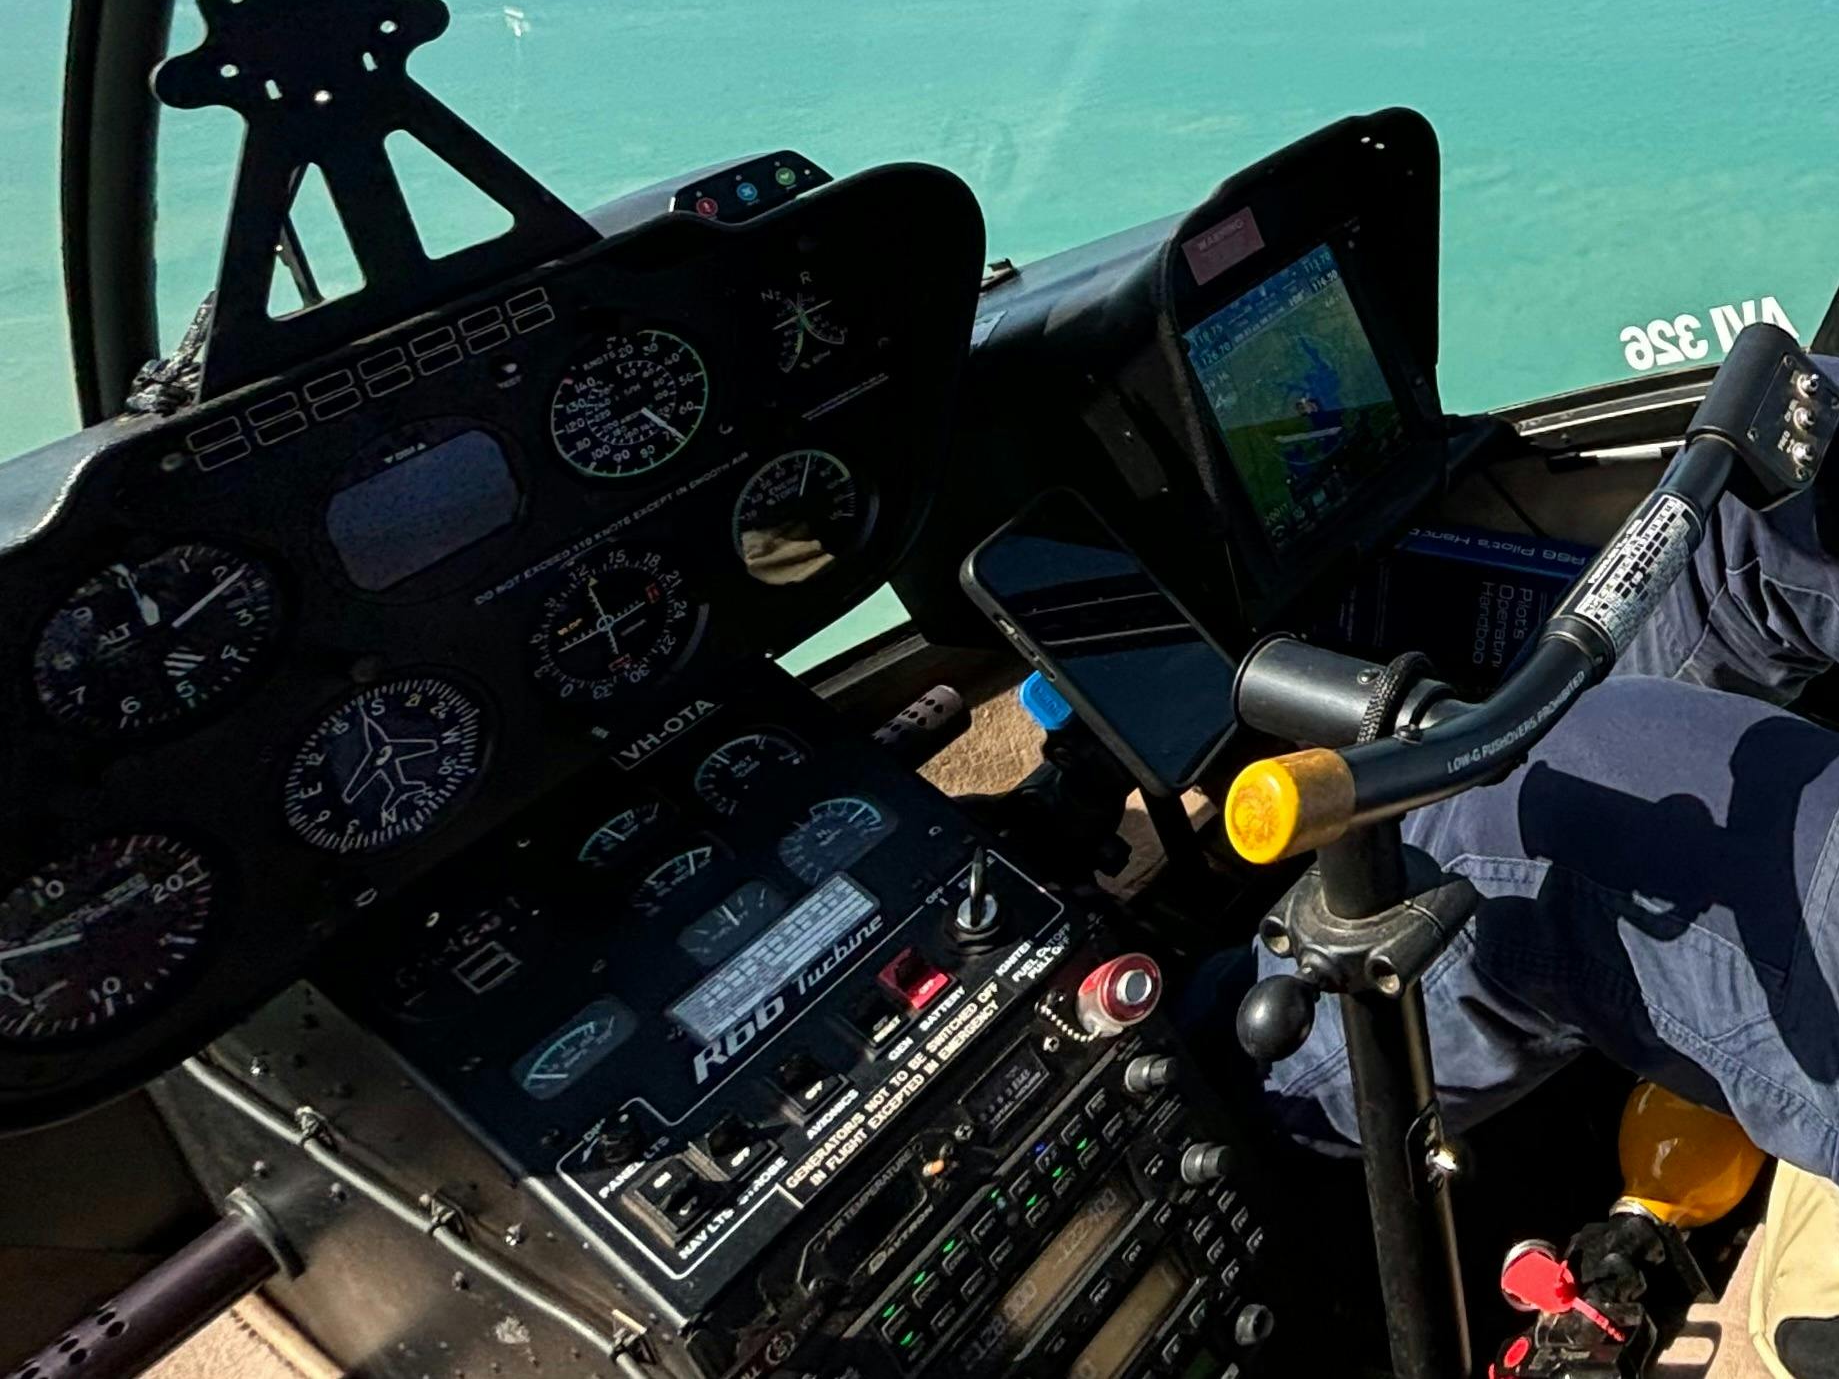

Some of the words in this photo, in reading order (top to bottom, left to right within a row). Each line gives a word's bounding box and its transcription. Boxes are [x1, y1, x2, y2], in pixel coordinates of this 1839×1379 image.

[524, 549, 571, 578] EXCEED
[608, 549, 626, 564] 15
[643, 552, 661, 566] 18
[1477, 538, 1536, 558] Pilot's
[234, 608, 256, 627] 3
[1473, 580, 1495, 665] Handboo
[1492, 583, 1515, 669] Operatin
[120, 696, 142, 714] 6
[176, 680, 196, 698] 5
[371, 698, 386, 715] S
[620, 698, 716, 762] VH-OTA
[1447, 748, 1481, 774] LOW-G
[1482, 716, 1538, 757] PUSHOVERS
[151, 873, 185, 904] 20
[1011, 956, 1037, 982] FUEL
[1027, 953, 1053, 979] PULL
[694, 995, 787, 1085] R66
[793, 914, 886, 996] Turbine
[918, 985, 966, 1032] BATTERY
[886, 1036, 913, 1062] GEN
[785, 1111, 866, 1189] GENERATOR/S
[864, 1087, 889, 1113] NOT
[889, 1068, 909, 1089] TO
[908, 1051, 927, 1071] BE
[926, 1001, 978, 1053] SWITCHED
[977, 981, 999, 1003] OFF
[809, 1167, 827, 1186] IN
[825, 1127, 869, 1170] FLIGHT
[868, 1073, 925, 1130] EXCEPTED
[925, 1058, 940, 1074] IN
[938, 999, 1000, 1061] EMERGENCY
[805, 1087, 860, 1139] AVIONICS
[598, 1156, 646, 1199] PANEL
[643, 1134, 670, 1160] LTS
[844, 1148, 914, 1220] TEMPERATURE
[678, 1229, 709, 1260] NAV
[706, 1205, 735, 1234] LTS
